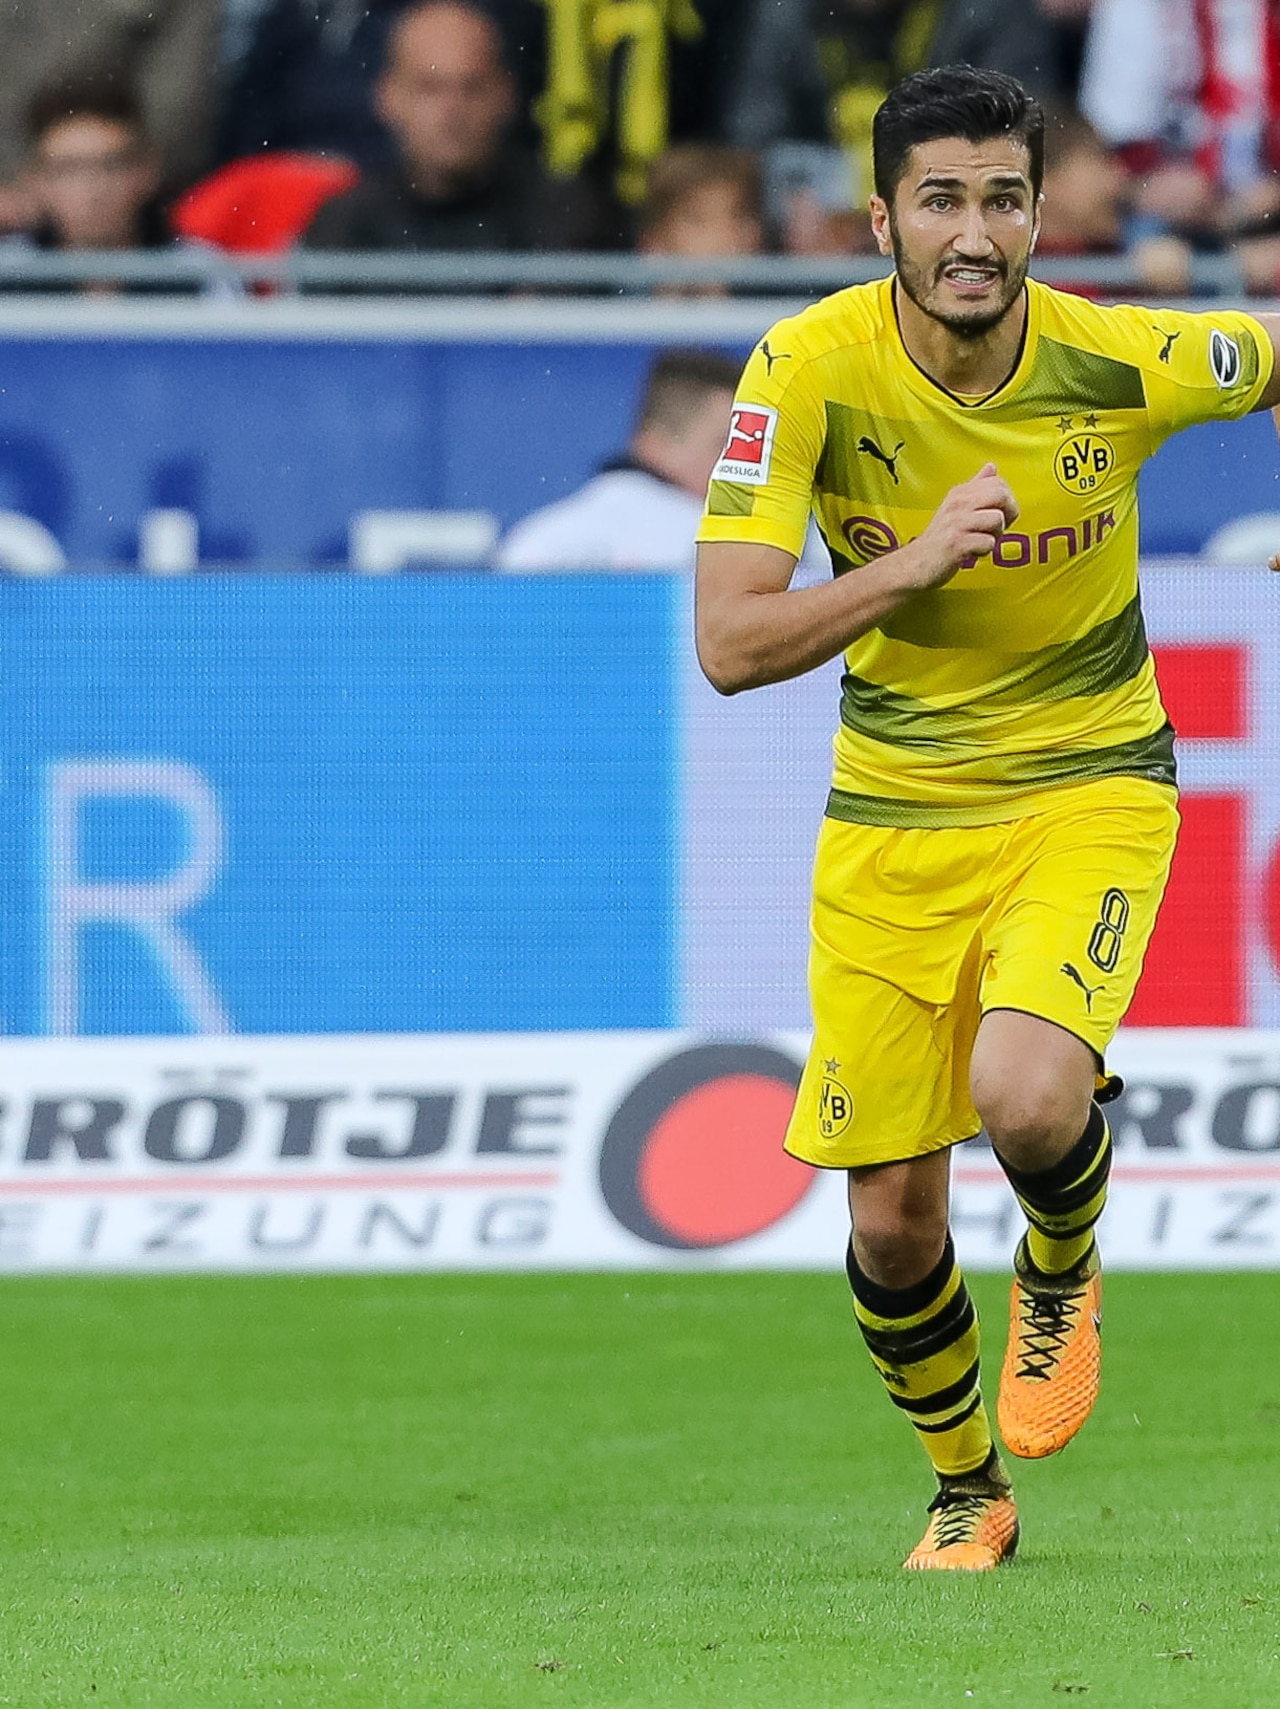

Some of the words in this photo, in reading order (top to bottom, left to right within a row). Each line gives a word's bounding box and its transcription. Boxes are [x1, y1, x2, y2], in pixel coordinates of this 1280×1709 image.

[1062, 438, 1109, 481] BVB
[1079, 474, 1096, 490] 09
[46, 755, 238, 1036] R
[1087, 887, 1130, 973] 8
[0, 1066, 574, 1162] RÖTJE
[819, 1084, 846, 1119] VB
